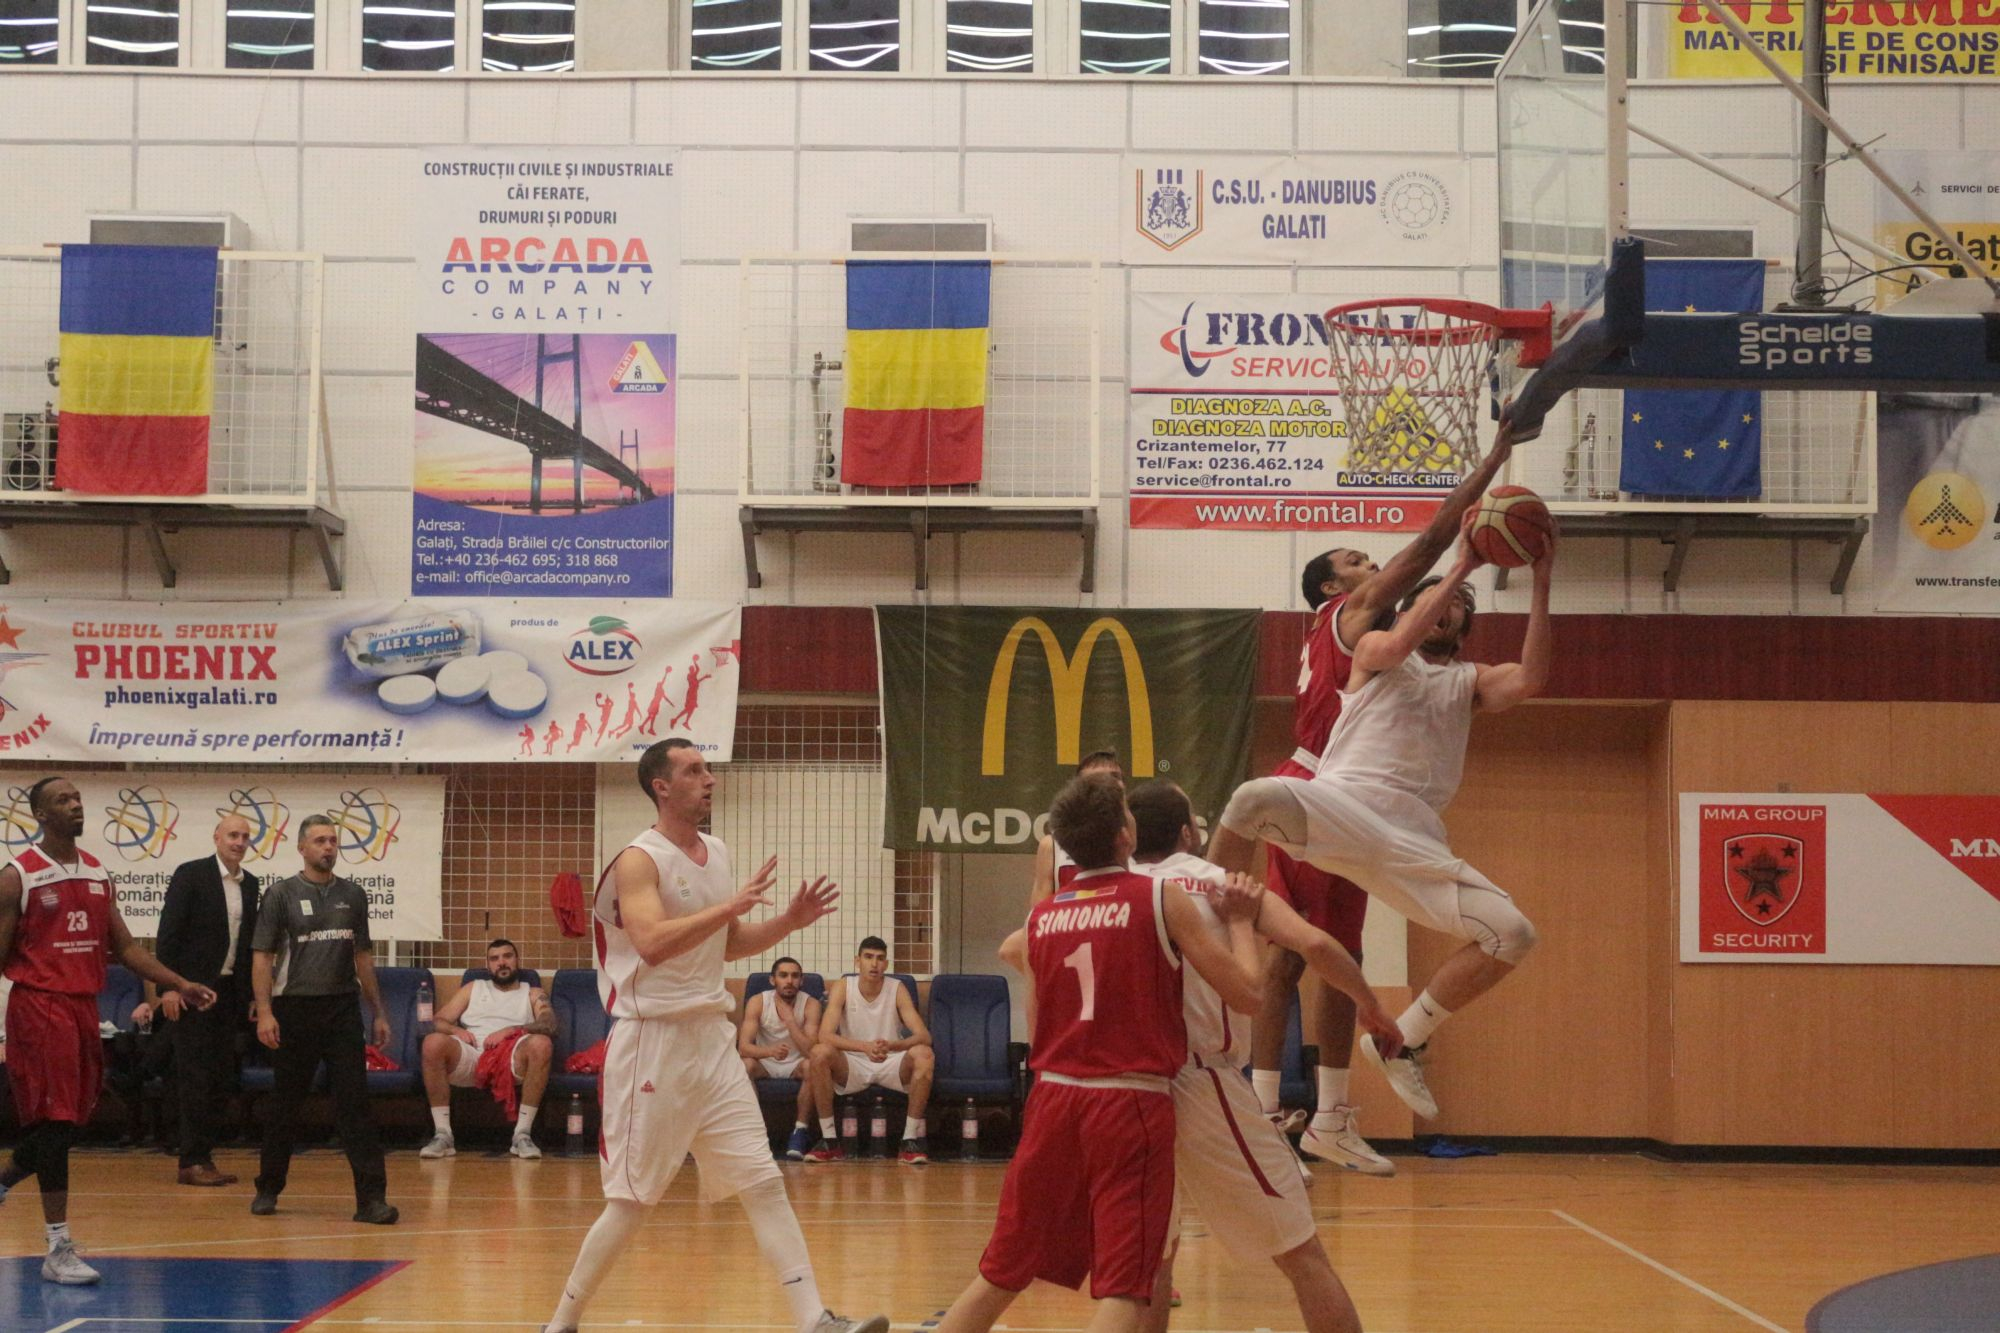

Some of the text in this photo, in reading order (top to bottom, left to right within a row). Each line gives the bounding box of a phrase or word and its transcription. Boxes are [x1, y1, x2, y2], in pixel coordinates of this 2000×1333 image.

[1866, 32, 1904, 51] DE
[1824, 53, 1995, 75] SI FINISAJE
[518, 163, 562, 176] CIVILE
[582, 163, 673, 177] INDUSTRIALE
[507, 184, 589, 201] CĂI FERATE,
[1212, 179, 1265, 204] C.S.U.
[1282, 180, 1376, 205] DANUBIUS
[1941, 185, 1982, 193] SERVICII
[479, 211, 543, 223] DRUMURI
[564, 212, 617, 224] PODURI
[1262, 214, 1326, 239] GALATI
[442, 237, 653, 273] ARCADA
[442, 280, 652, 294] COMPANY
[1740, 322, 1872, 342] Schelde
[1740, 344, 1872, 369] Sports
[1231, 358, 1345, 378] SERVICE
[622, 384, 658, 392] ARCADA
[1171, 398, 1331, 416] DIAGNOZA A.C.
[1153, 419, 1347, 437] DIAGNOZA MOTOR
[1136, 439, 1287, 454] Crizantemelor, 77
[1137, 457, 1324, 470] Tel/Fax: 0236.462.124
[1136, 474, 1292, 488] service@frontal.ro
[1195, 500, 1404, 524] www.frontal.ro
[417, 519, 465, 531] Adresa:
[462, 537, 503, 550] Strada
[508, 537, 547, 549] Brăilei
[552, 537, 570, 550] c/c
[575, 536, 669, 549] Constructorilor
[475, 554, 527, 566] 236-462
[532, 554, 560, 568] 695;
[566, 554, 589, 566] 318
[594, 554, 618, 566] 868
[416, 571, 630, 585] e-mail: office@arcadacompany.ro
[1915, 576, 2000, 586] www.transfe
[72, 622, 278, 640] CLUBUL SPORTIV
[510, 618, 545, 627] produs
[376, 630, 459, 652] ALEX Sprint
[569, 640, 635, 660] ALEX
[74, 645, 277, 680] PHOENIX
[105, 685, 278, 708] phoenixgalati.ro
[89, 722, 198, 750] Împreună
[201, 734, 249, 751] spre
[1704, 808, 1823, 821] MMA GROUP
[67, 911, 88, 932] 23
[1036, 902, 1131, 938] SIMIONCA
[1713, 934, 1812, 947] SECURITY
[1064, 942, 1095, 1021] 1
